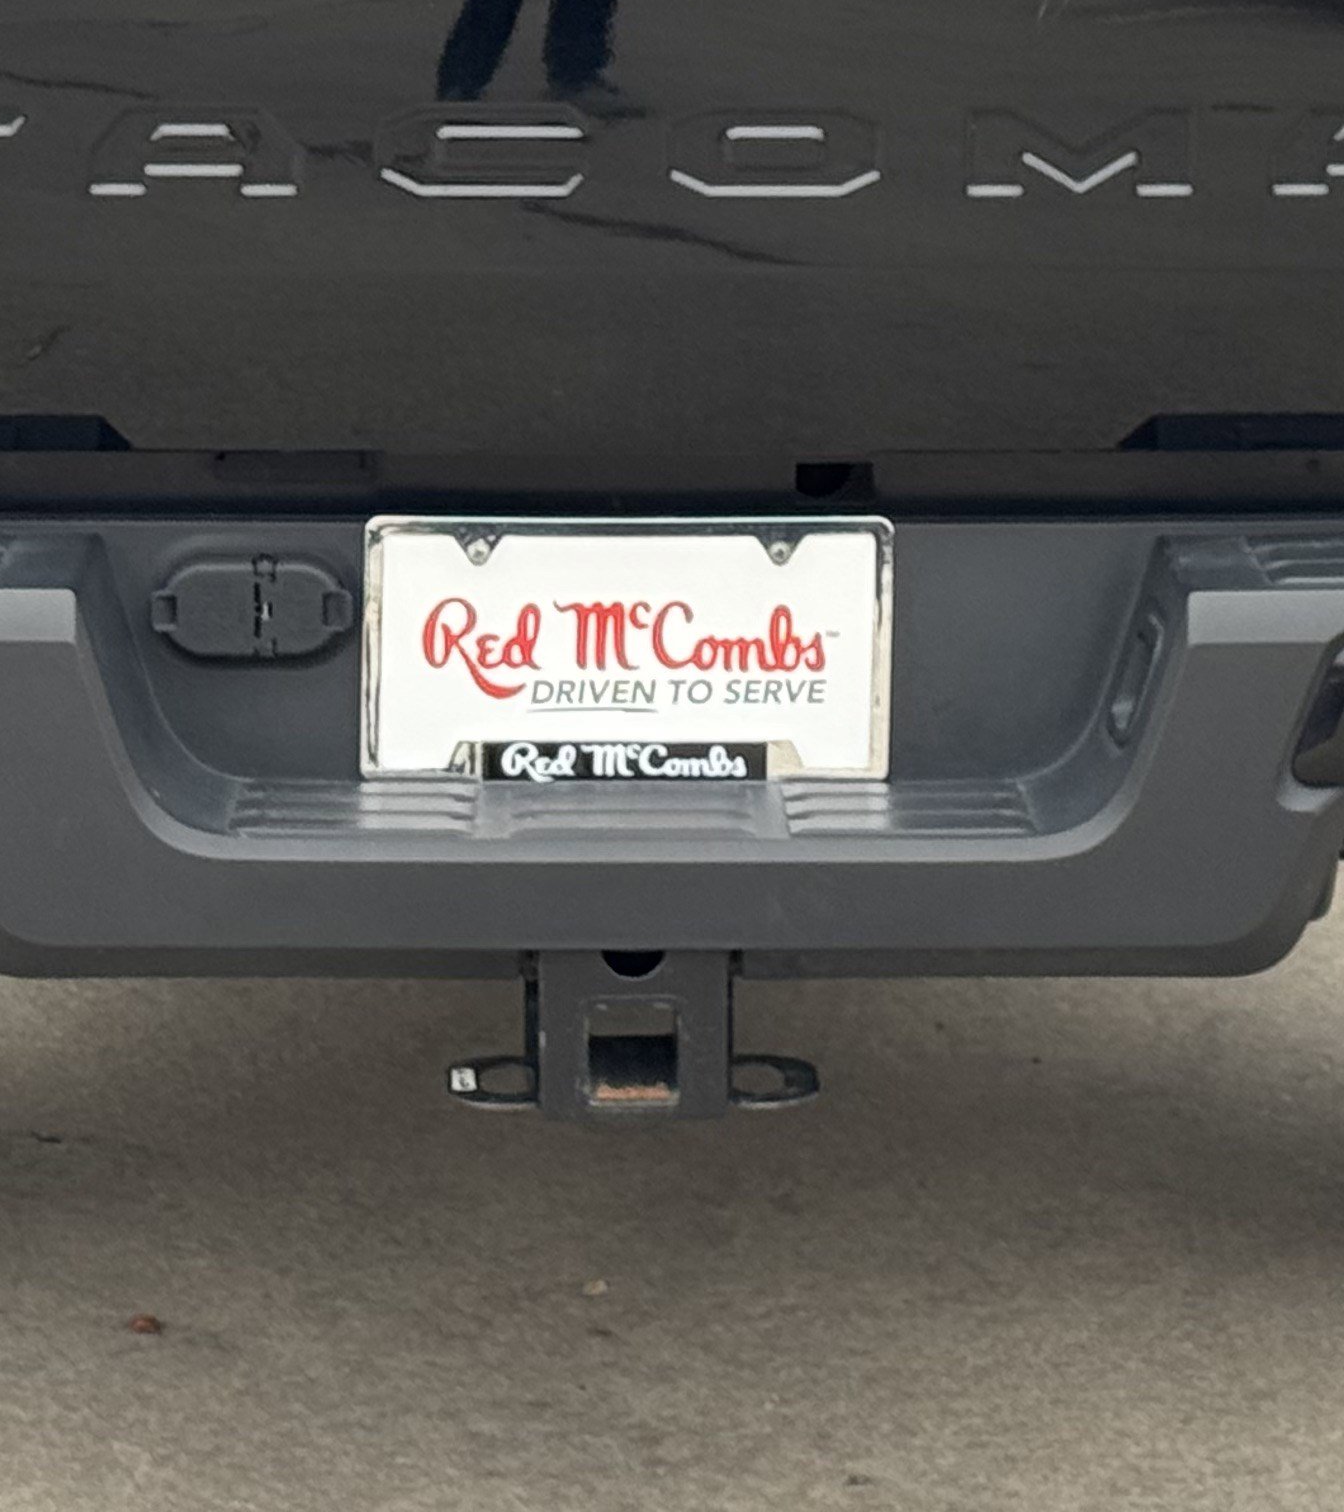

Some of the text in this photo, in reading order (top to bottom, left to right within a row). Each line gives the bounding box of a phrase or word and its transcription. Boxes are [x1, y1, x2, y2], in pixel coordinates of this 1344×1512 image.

[421, 597, 827, 700] Red McCombs
[530, 678, 828, 705] DRIVEN TO SERVE
[500, 741, 748, 784] Red McCombs
